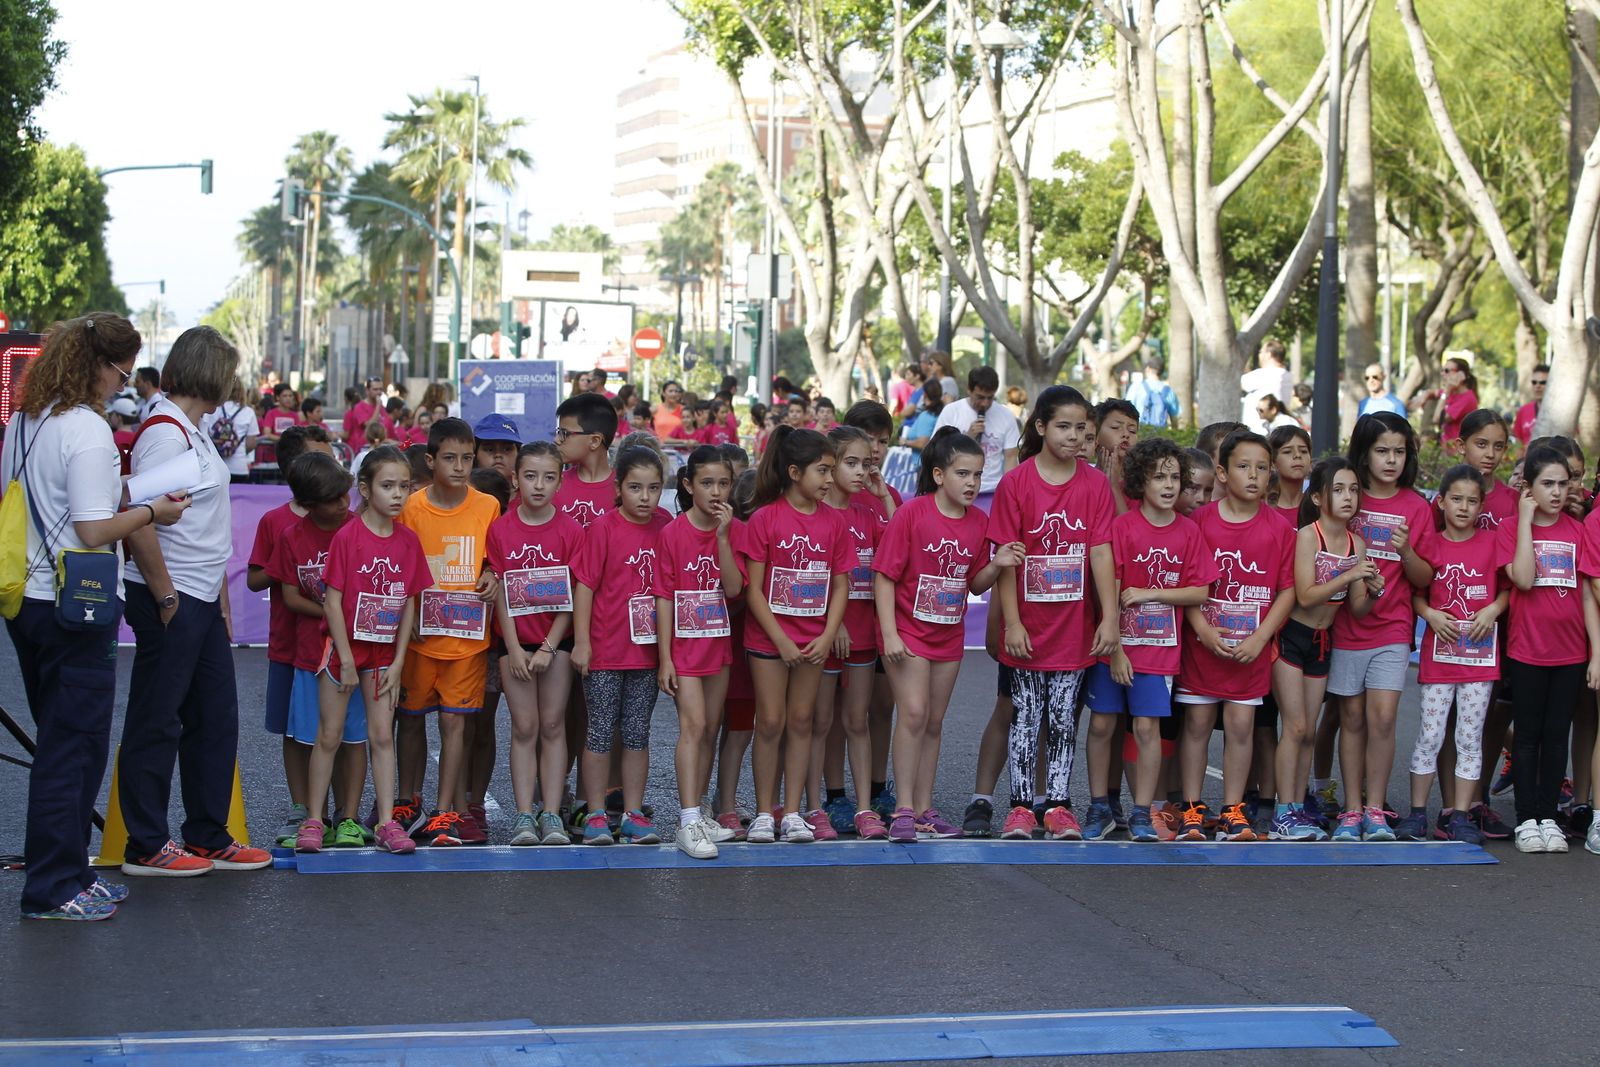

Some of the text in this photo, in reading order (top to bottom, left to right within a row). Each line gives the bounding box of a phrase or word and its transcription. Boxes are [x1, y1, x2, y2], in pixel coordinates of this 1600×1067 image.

[496, 383, 515, 391] 2005
[1362, 525, 1392, 542] 185
[440, 565, 476, 575] CARRERA
[440, 574, 476, 583] SOLIDARIA
[81, 579, 102, 589] RFEA
[1245, 585, 1271, 594] CARRERA
[442, 604, 482, 621] 1706
